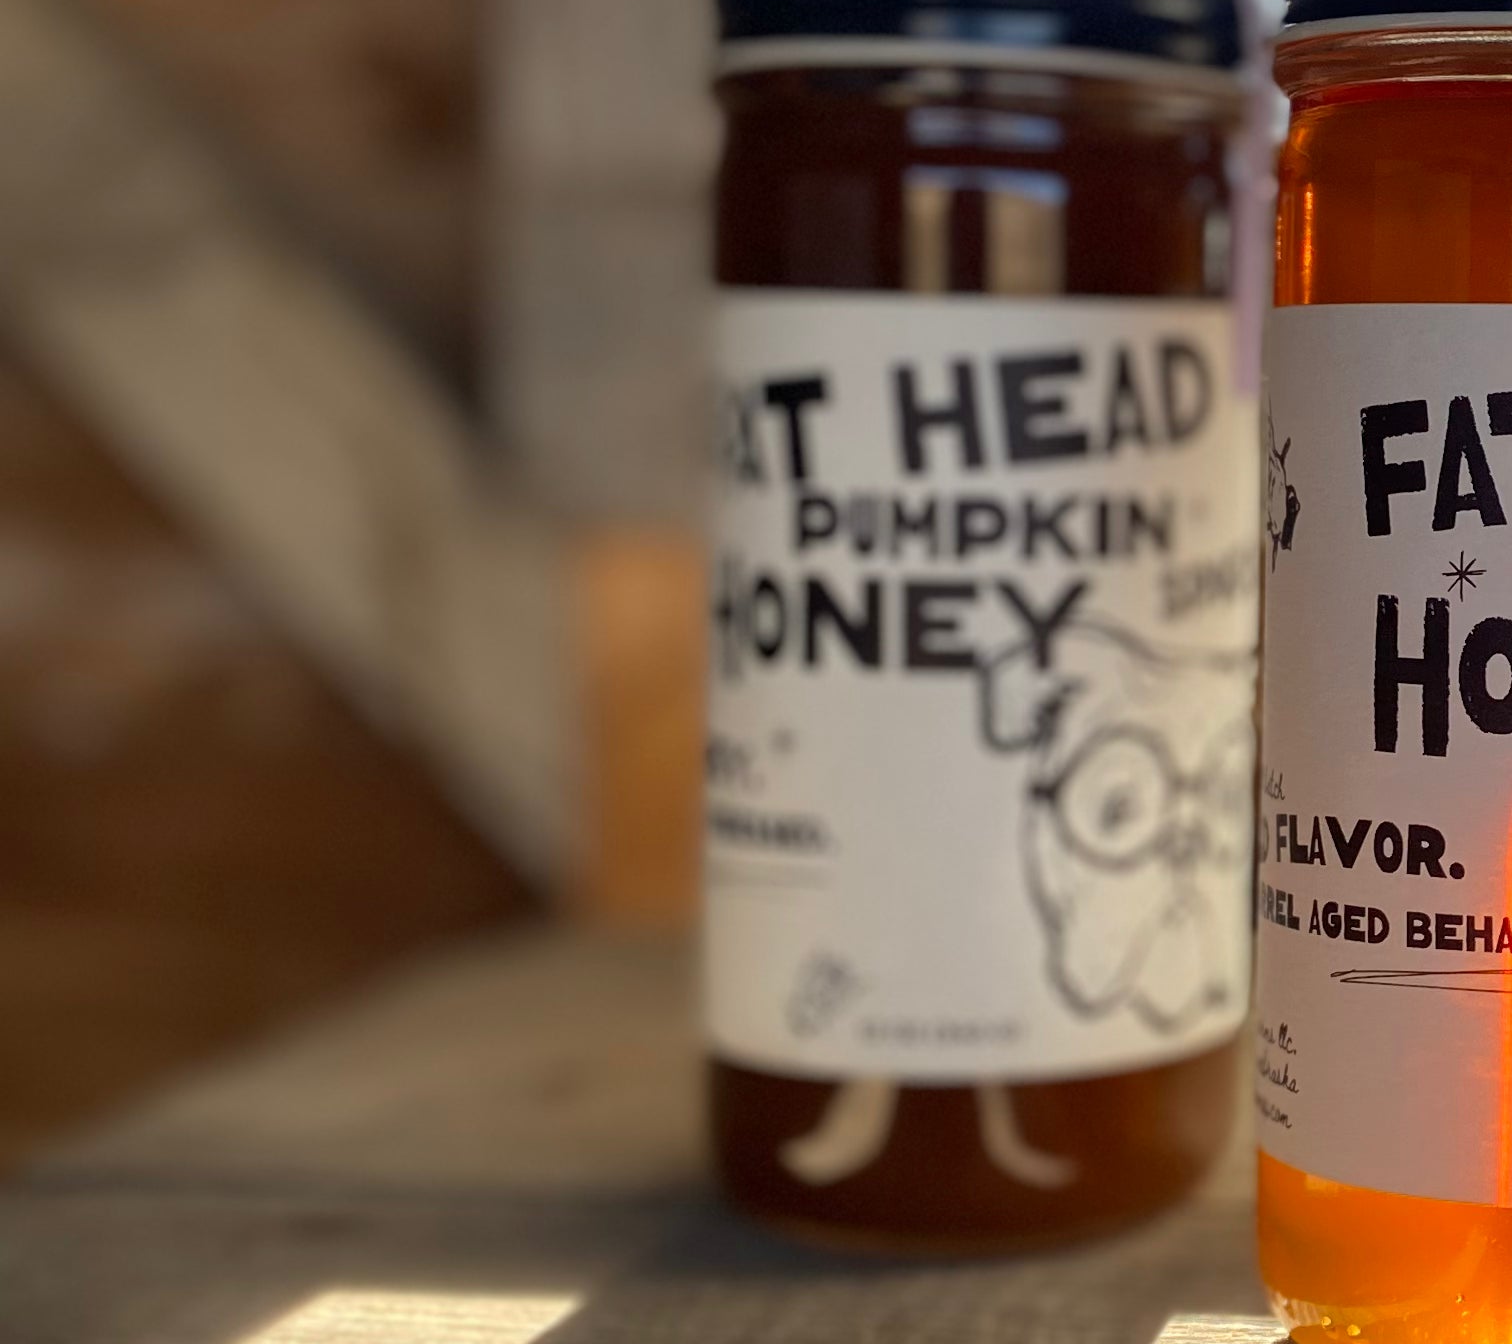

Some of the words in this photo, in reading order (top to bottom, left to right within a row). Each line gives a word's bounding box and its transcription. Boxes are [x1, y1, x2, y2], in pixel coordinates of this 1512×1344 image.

[893, 334, 1212, 476] HEAD
[796, 492, 1176, 560] PUMPKIN
[1275, 813, 1466, 881] FLAVOR.
[1308, 899, 1390, 944] AGED
